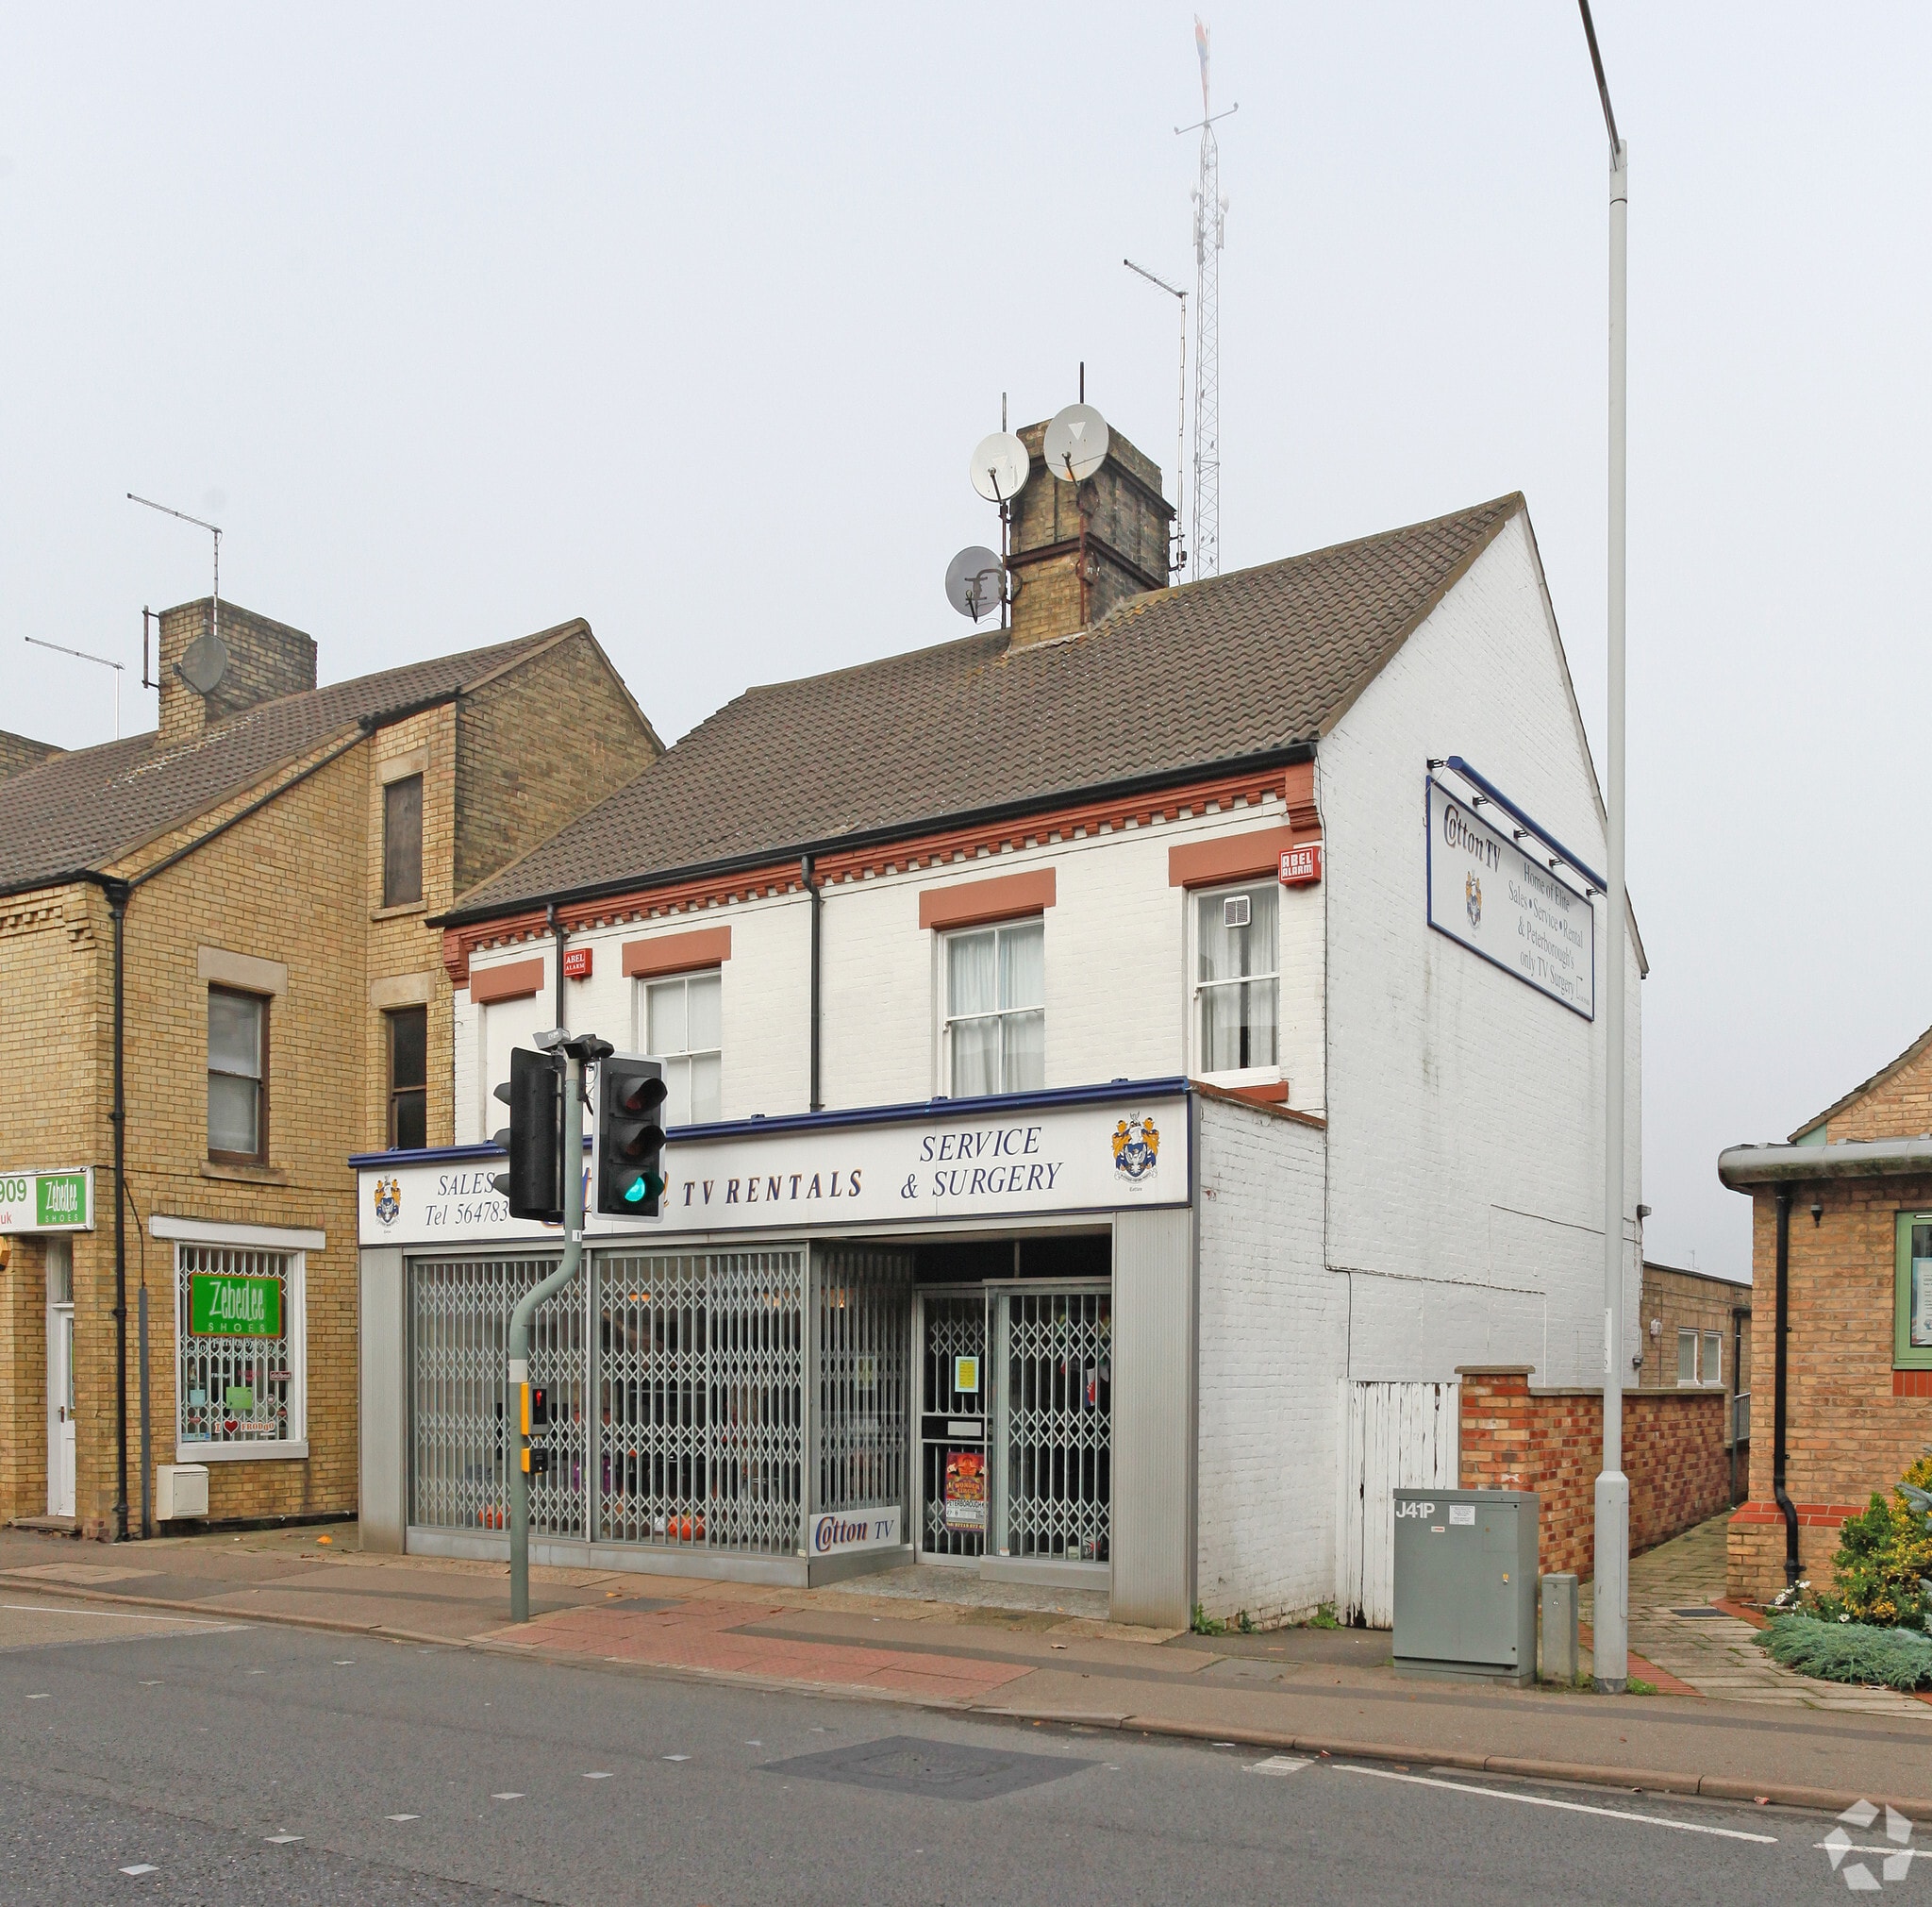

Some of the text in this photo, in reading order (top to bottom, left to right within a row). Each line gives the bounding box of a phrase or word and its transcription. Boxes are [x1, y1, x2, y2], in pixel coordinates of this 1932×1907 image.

[1444, 804, 1501, 873] Cotton TV
[1283, 852, 1311, 867] ABEL
[1283, 864, 1311, 877] ALARM
[1524, 862, 1570, 912] Home of Elite
[1508, 880, 1583, 949] Sales Service Rental
[566, 954, 584, 964] ABEL
[1518, 916, 1574, 970] & Peterborough's
[1521, 950, 1574, 1000] only TV Surgery
[920, 1127, 1041, 1162] SERVICE
[45, 1179, 77, 1213] Zebedee
[438, 1172, 495, 1196] SALES
[683, 1179, 715, 1206] TV
[725, 1168, 862, 1204] RENTALS
[901, 1162, 1064, 1199] & SURGERY
[45, 1213, 78, 1223] SHOES
[425, 1200, 508, 1226] Tel 564783
[208, 1280, 264, 1321] Zebedee
[208, 1323, 265, 1333] SHOES
[1396, 1501, 1436, 1518] J41P
[815, 1516, 894, 1553] Cotton TV
